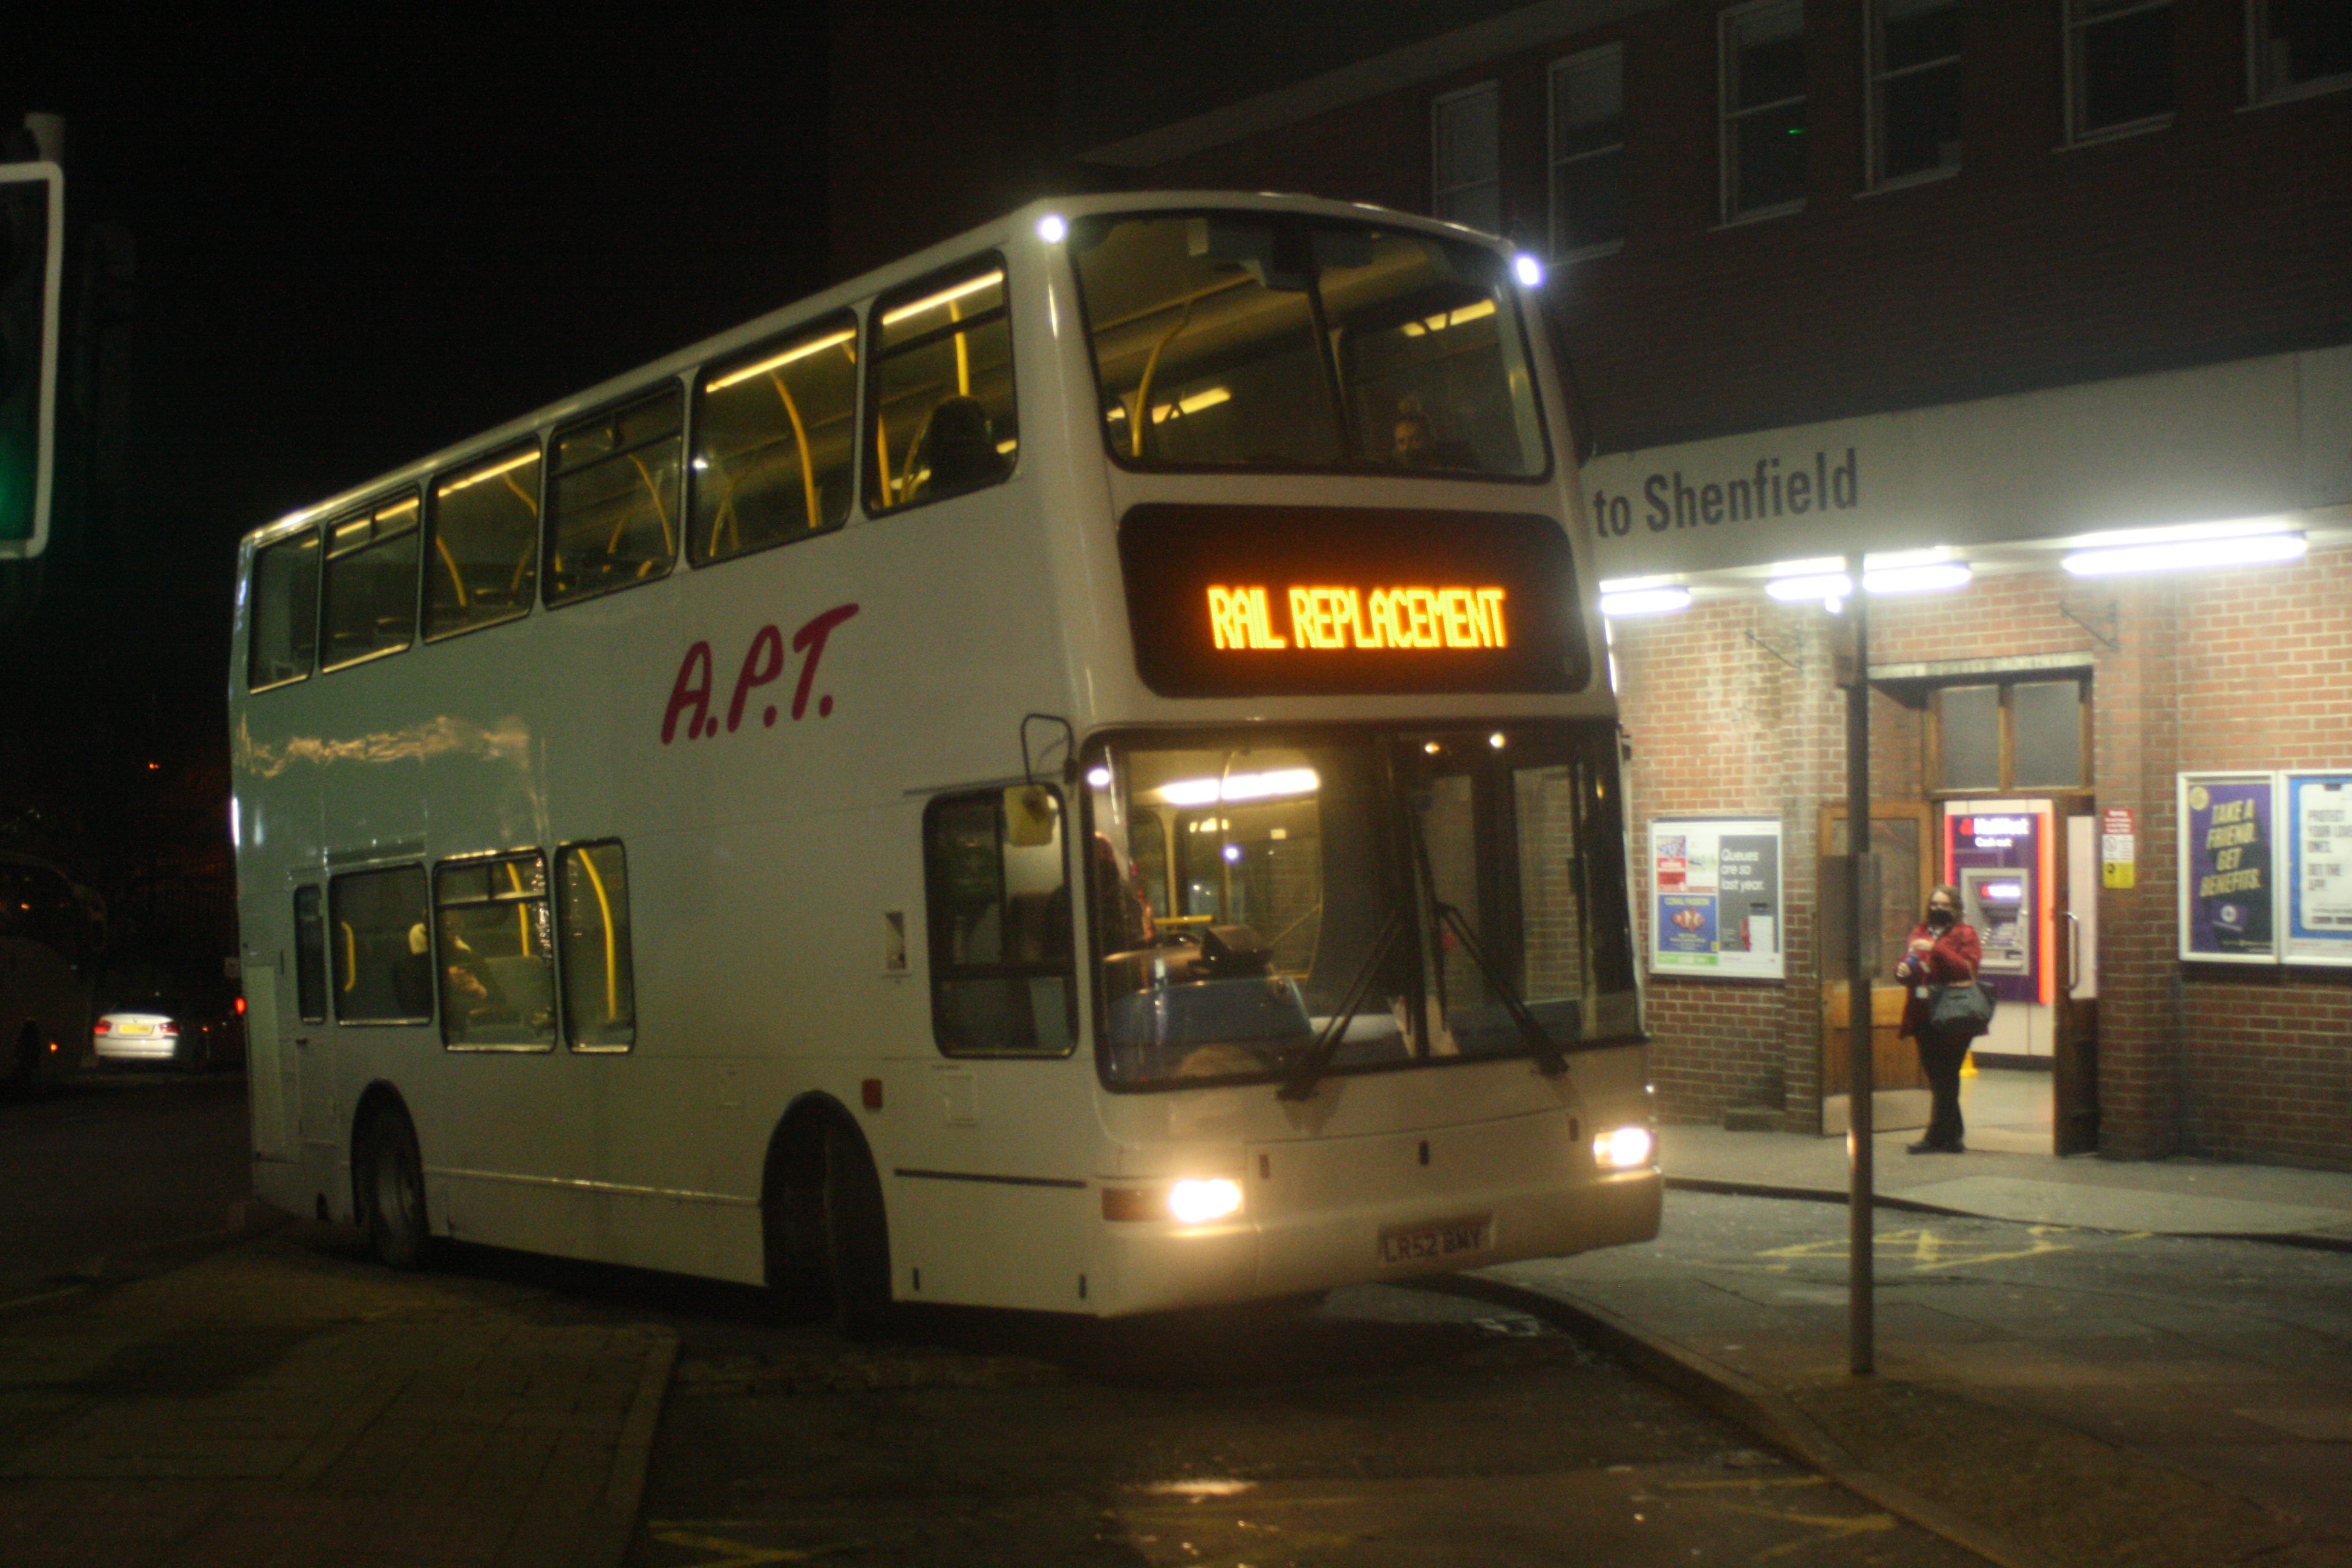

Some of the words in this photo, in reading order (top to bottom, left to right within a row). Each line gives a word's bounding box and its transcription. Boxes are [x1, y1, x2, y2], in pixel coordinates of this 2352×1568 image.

[1592, 489, 1632, 538] to
[1644, 447, 1858, 532] Shenfield
[1208, 587, 1286, 649] RAIL
[1289, 588, 1507, 649] REPLACEMENT
[660, 602, 860, 746] A.P.T.
[1720, 865, 1738, 875] are
[1739, 865, 1753, 875] so
[1721, 848, 1759, 861] Queues
[1720, 877, 1739, 890] last
